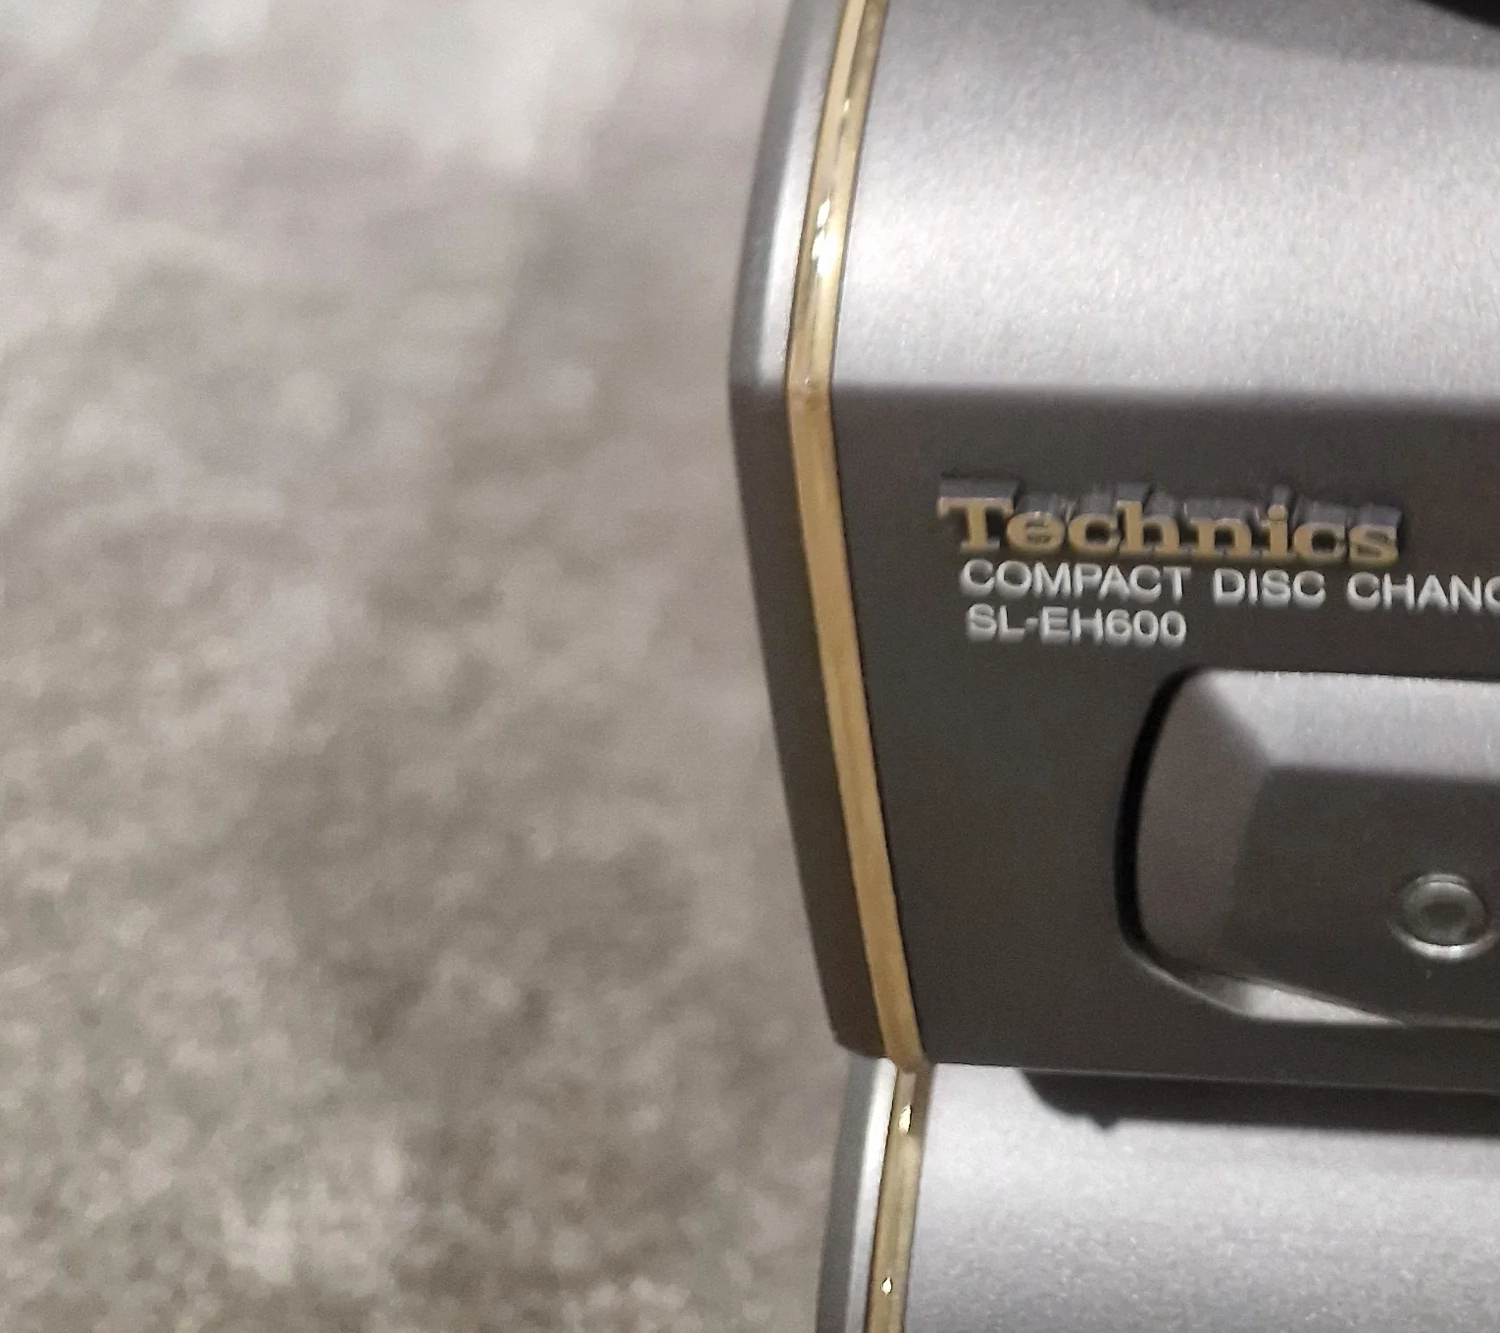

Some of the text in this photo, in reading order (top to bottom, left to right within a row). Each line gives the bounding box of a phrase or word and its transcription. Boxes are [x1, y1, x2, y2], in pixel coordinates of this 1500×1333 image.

[937, 489, 1402, 567] Technics
[959, 558, 1191, 602] COMPACT
[1213, 567, 1326, 609] DISC
[966, 604, 1188, 647] SL-EH600
